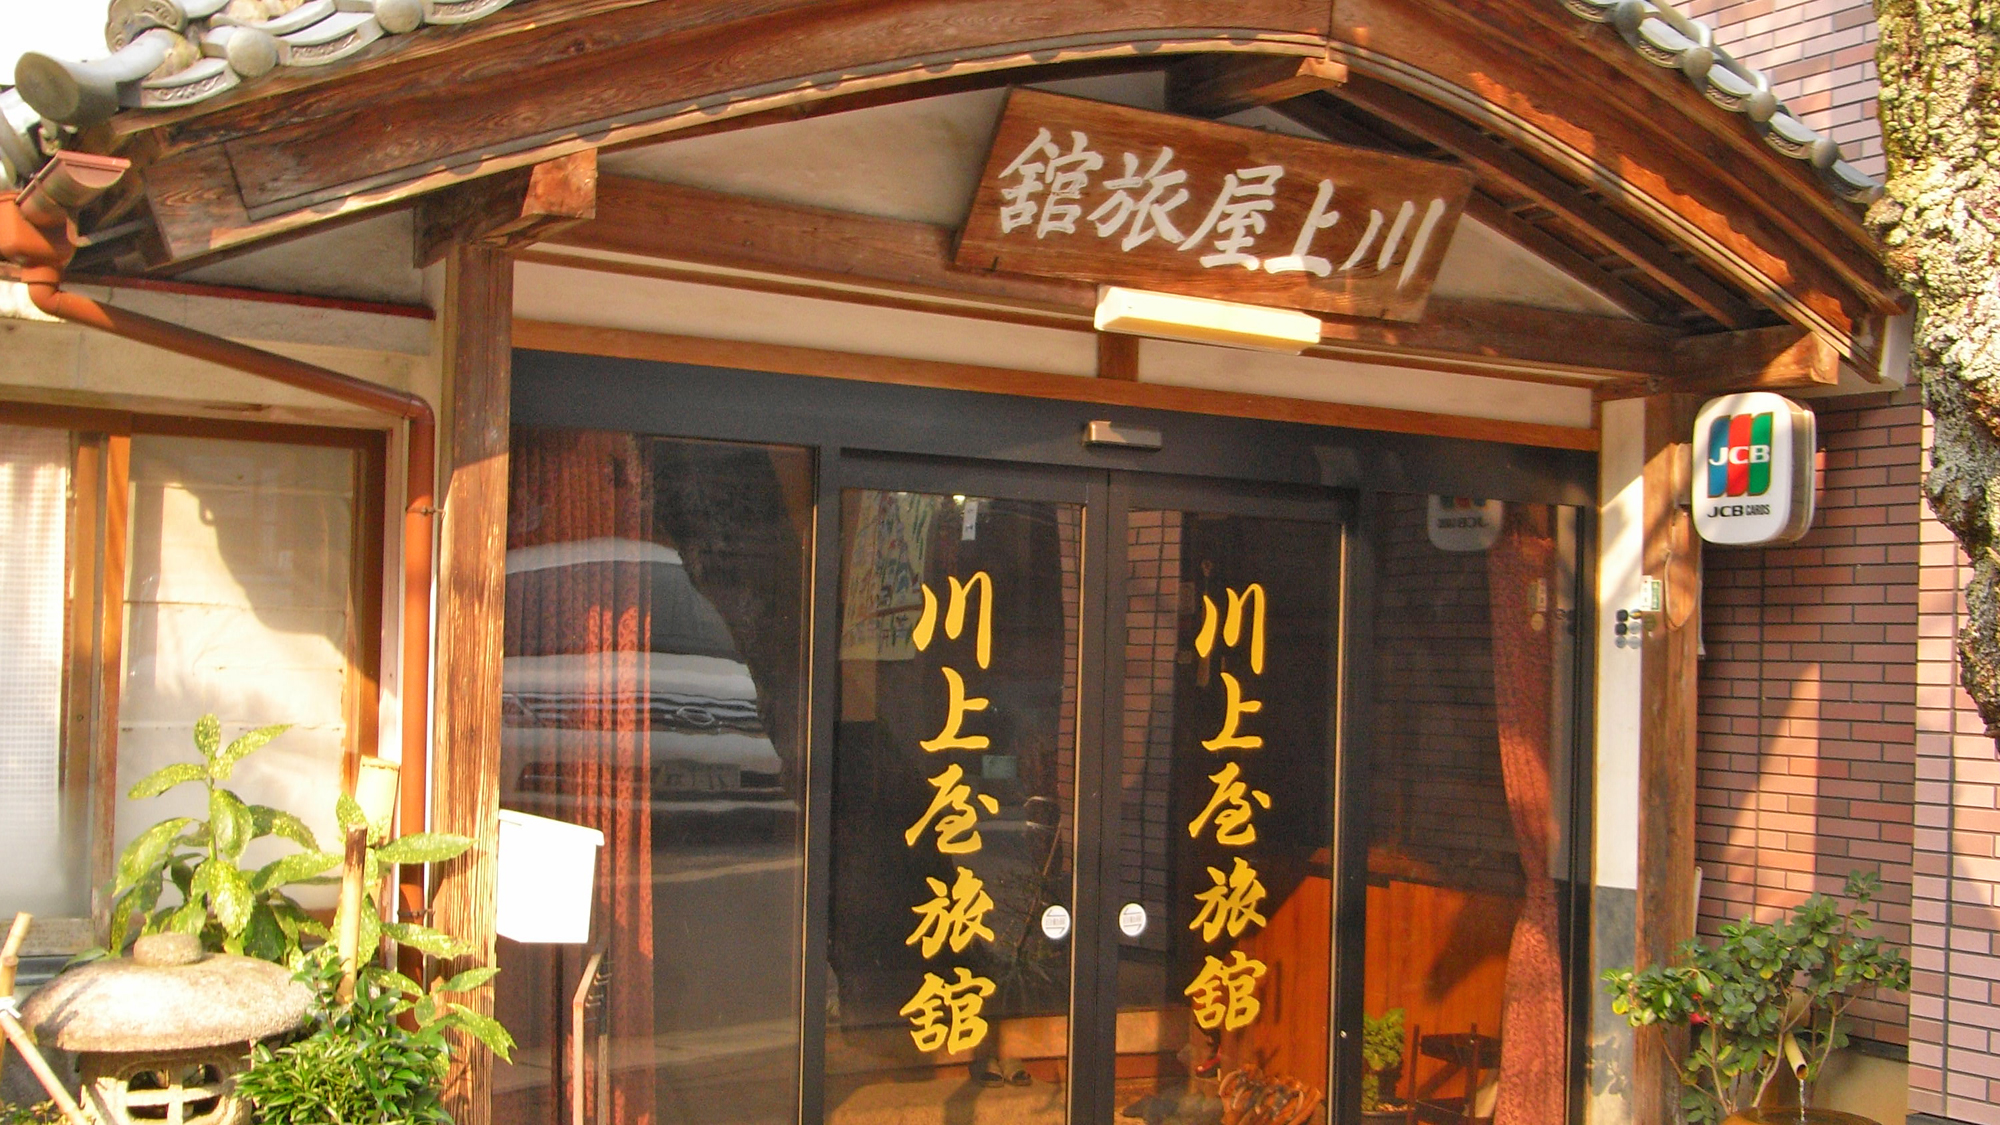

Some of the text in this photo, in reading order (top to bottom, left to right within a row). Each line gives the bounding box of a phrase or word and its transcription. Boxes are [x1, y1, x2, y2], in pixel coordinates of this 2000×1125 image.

[1708, 445, 1771, 466] JCB
[1707, 504, 1770, 518] JCB CARDS
